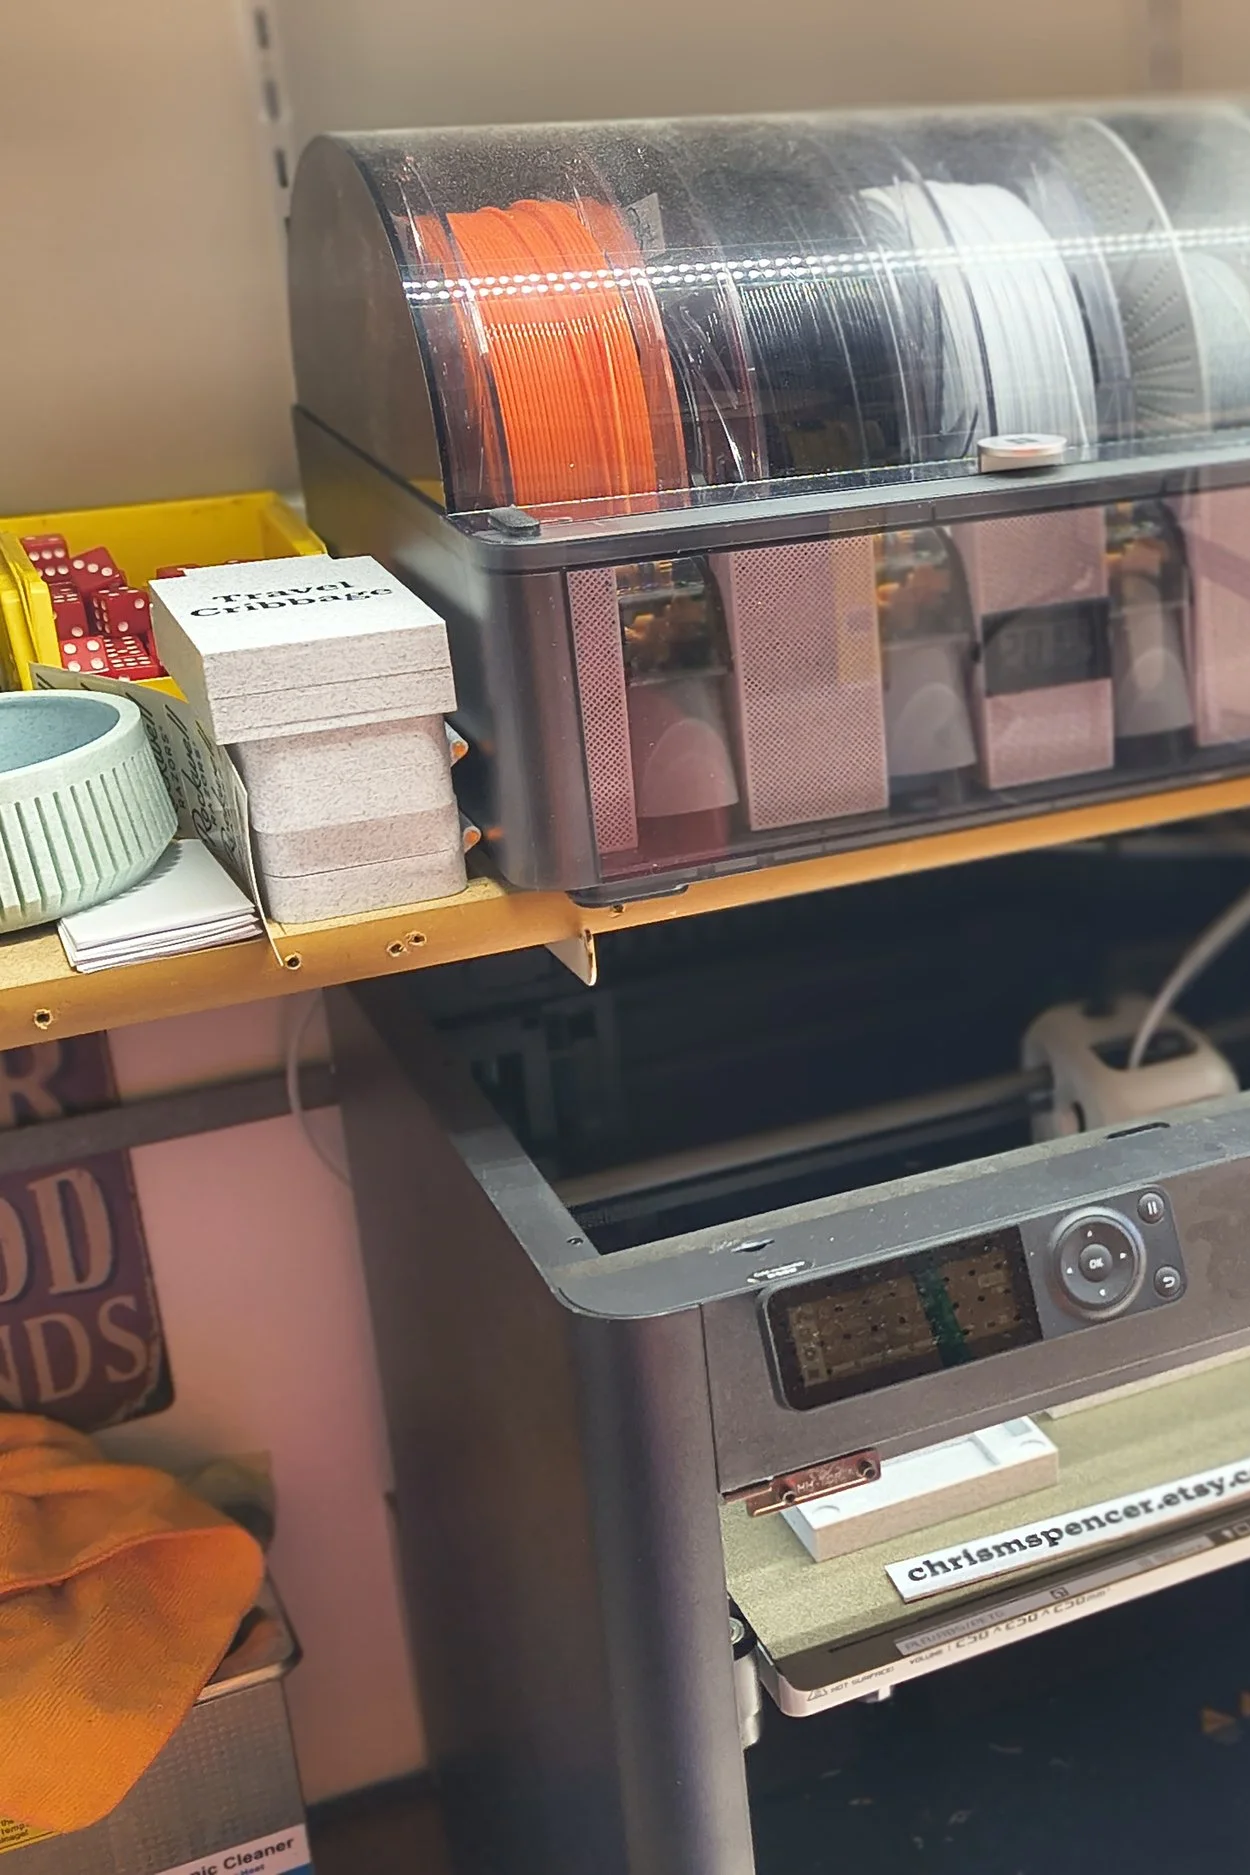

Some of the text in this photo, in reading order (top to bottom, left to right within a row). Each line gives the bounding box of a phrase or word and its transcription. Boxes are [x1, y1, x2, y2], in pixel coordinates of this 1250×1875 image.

[190, 588, 393, 617] Cribbage
[212, 581, 355, 603] Travel
[165, 704, 216, 848] Rockwell
[223, 1838, 294, 1869] Cleaner
